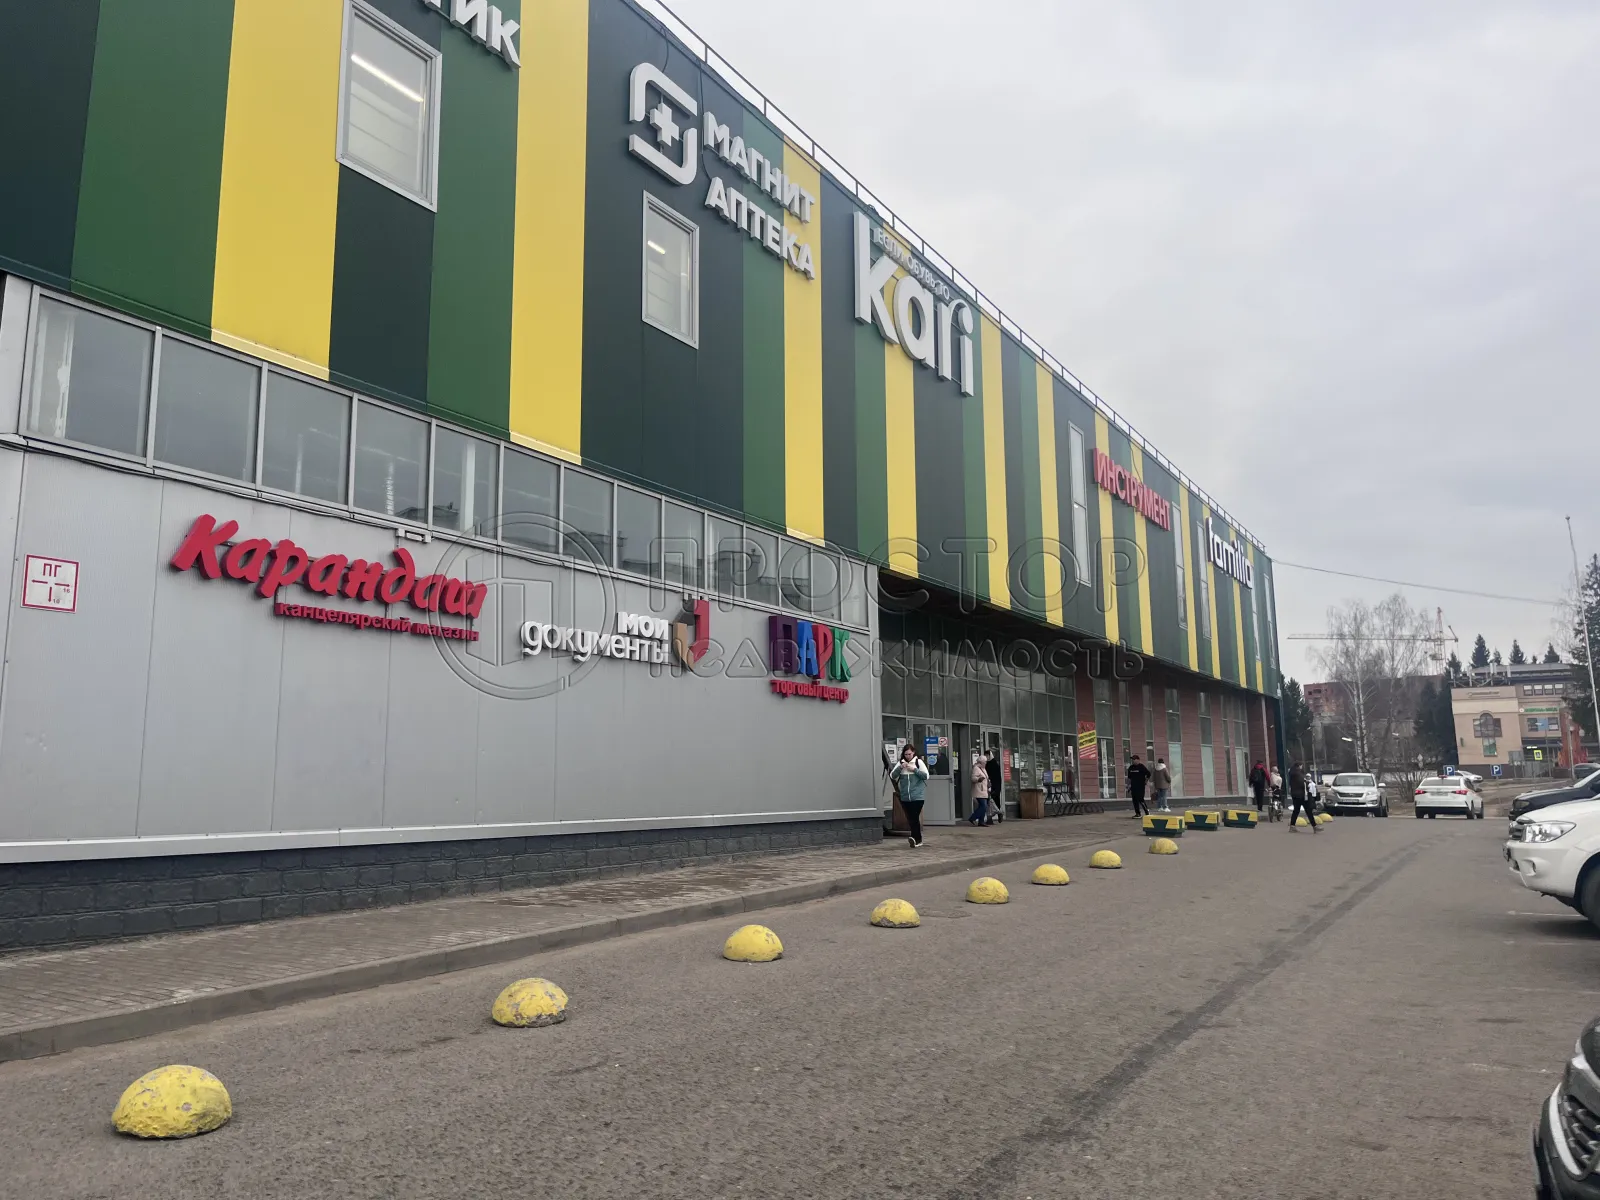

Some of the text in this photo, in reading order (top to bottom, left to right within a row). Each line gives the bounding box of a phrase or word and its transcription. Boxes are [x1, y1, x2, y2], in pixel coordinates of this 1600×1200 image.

[424, 0, 521, 68] ИК
[703, 111, 816, 224] МАГНИТ
[705, 176, 815, 280] АПТЕКА
[854, 211, 974, 396] kari
[42, 562, 62, 577] ПГ
[170, 513, 488, 619] Карандаш
[1204, 516, 1253, 590] familia
[275, 602, 480, 642] канцелярский магазин
[521, 620, 669, 664] документы
[768, 615, 852, 683] ПАРК
[770, 679, 849, 704] торговый центр
[1446, 766, 1453, 775] P
[1493, 765, 1502, 775] P
